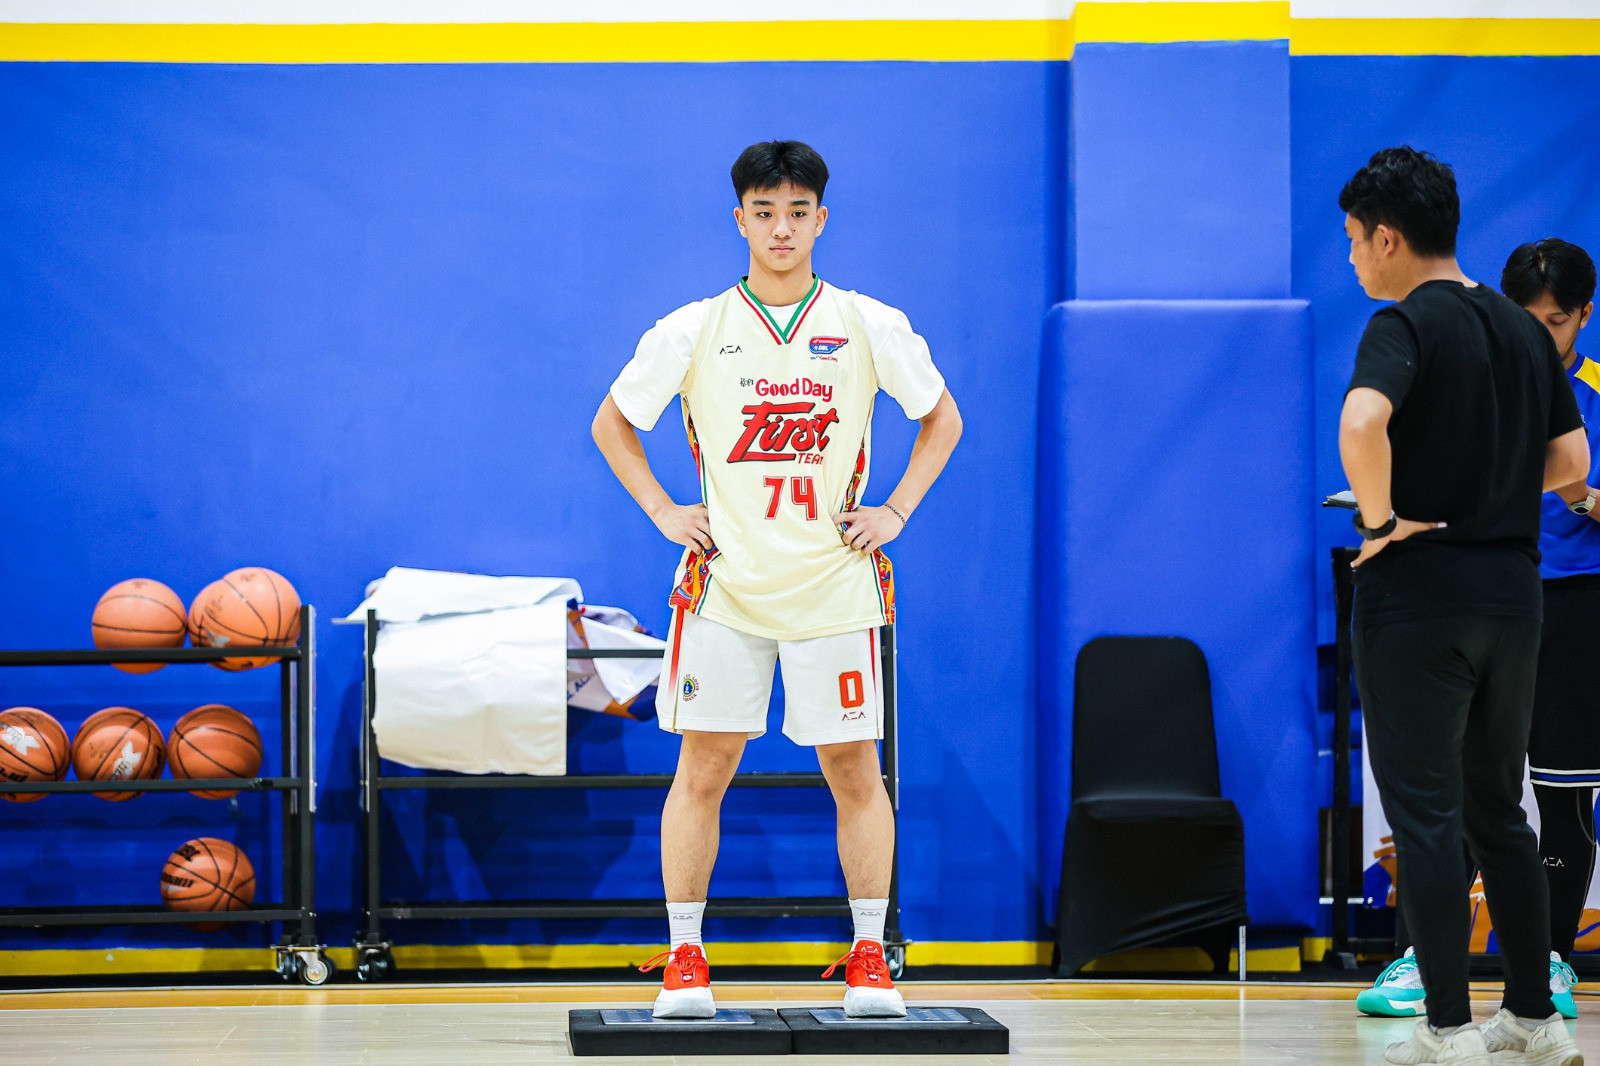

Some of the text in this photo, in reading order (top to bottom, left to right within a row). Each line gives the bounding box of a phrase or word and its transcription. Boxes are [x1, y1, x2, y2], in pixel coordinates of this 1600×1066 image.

[755, 378, 800, 397] Good
[802, 378, 833, 402] Day
[726, 401, 840, 464] First
[763, 475, 818, 521] 74
